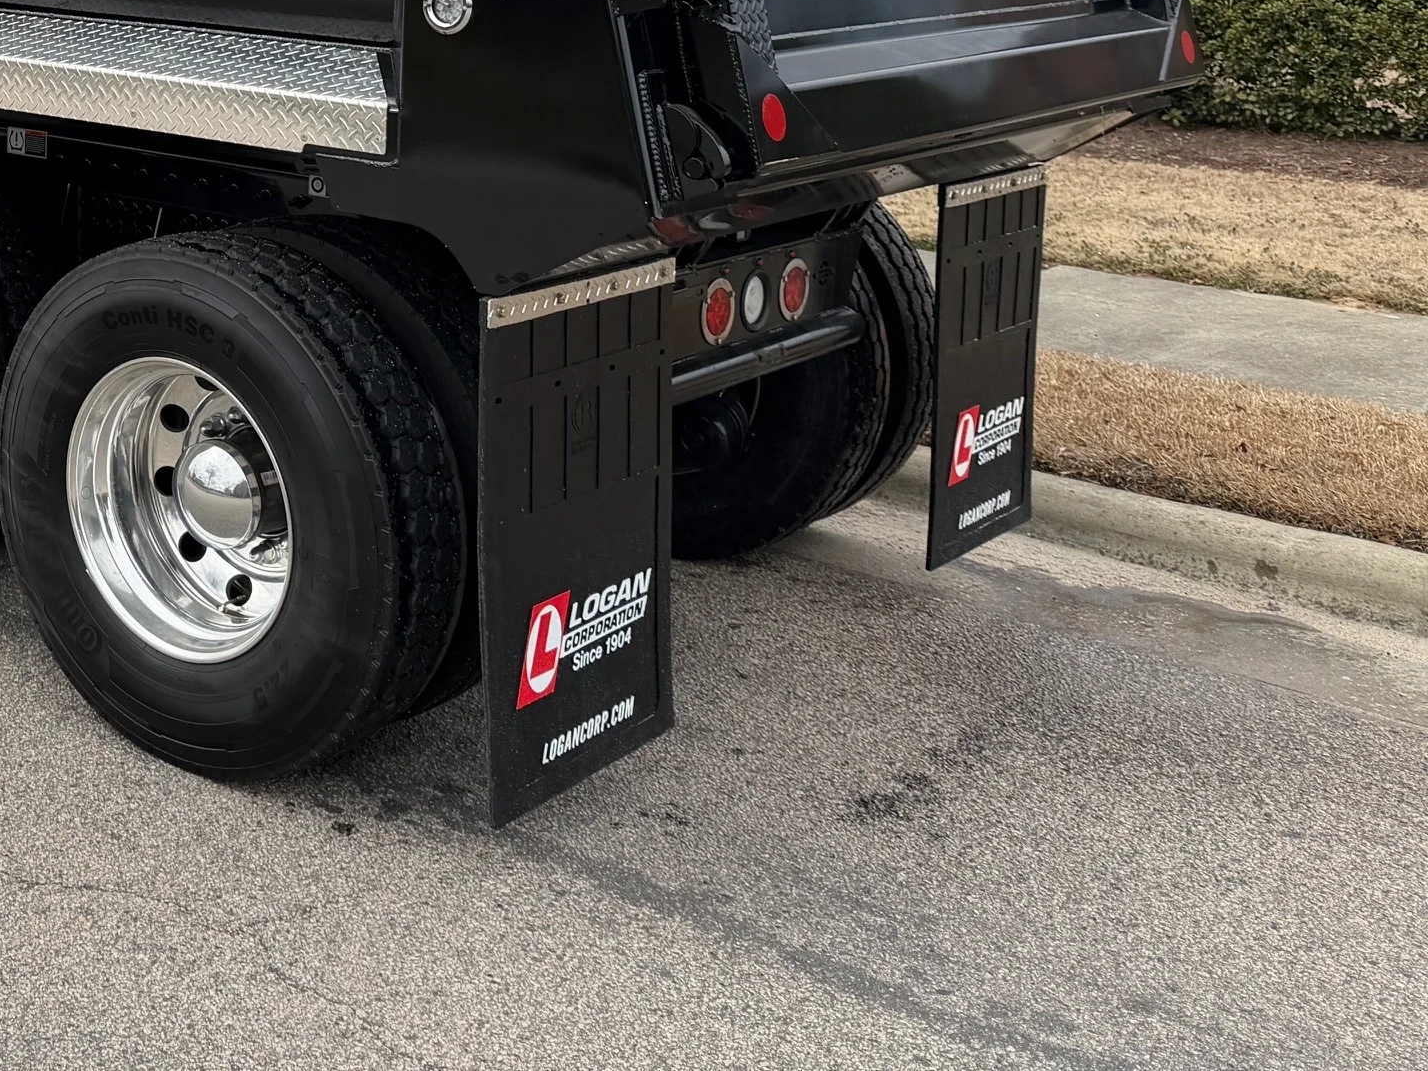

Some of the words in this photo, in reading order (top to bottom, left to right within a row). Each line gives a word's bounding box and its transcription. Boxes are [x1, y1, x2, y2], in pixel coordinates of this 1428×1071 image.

[102, 305, 159, 330] Conti
[166, 308, 215, 345] HSC
[222, 337, 236, 359] 3
[974, 420, 1019, 450] CORPORATION
[976, 396, 1025, 434] LOGAN
[977, 447, 996, 466] Since
[996, 438, 1012, 457] 1904
[958, 489, 1012, 530] LOGANCORP.COM
[568, 567, 652, 629] LOGAN
[563, 600, 644, 652] CORPORATION
[572, 644, 603, 672] Since
[605, 626, 632, 655] 1904
[542, 695, 635, 765] LOGANCORP.COM
